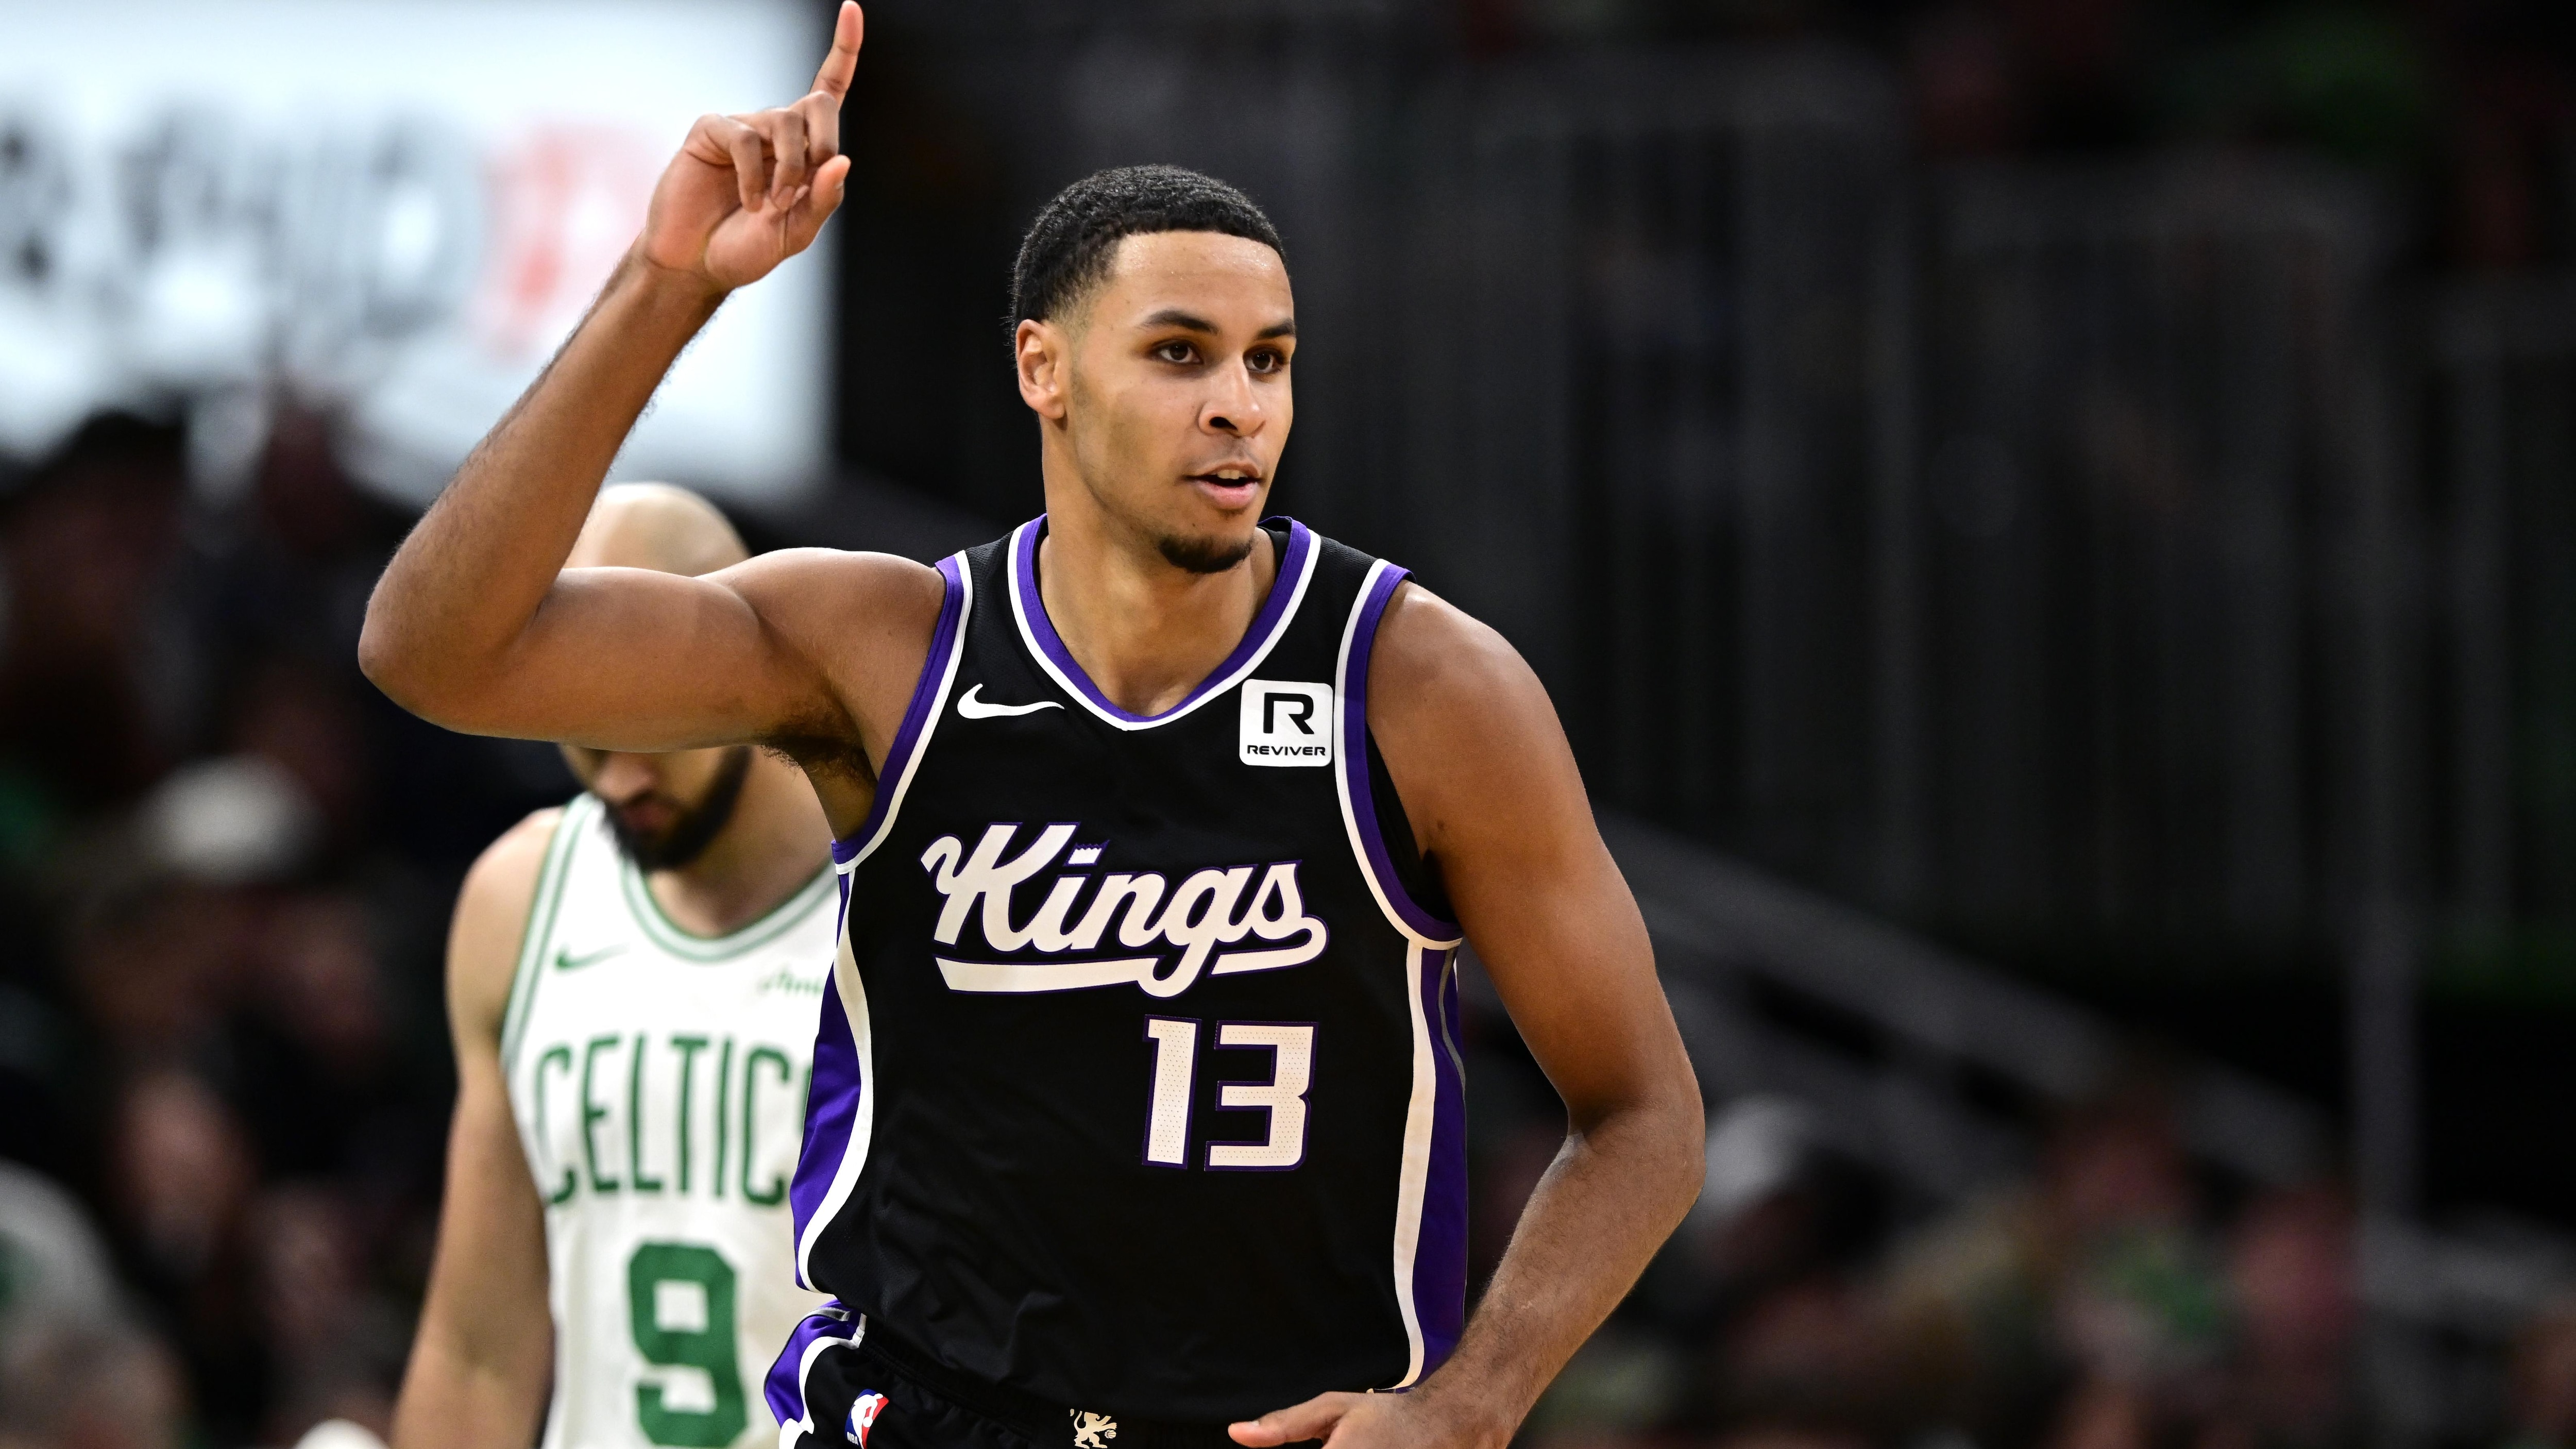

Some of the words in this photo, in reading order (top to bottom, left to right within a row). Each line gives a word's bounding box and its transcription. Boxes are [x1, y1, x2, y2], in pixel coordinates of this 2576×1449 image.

[1247, 745, 1326, 756] REVIVER
[1263, 692, 1315, 735] R
[920, 821, 1330, 1000] Kings
[532, 1032, 815, 1207] CELTIC
[1141, 1014, 1319, 1172] 13
[628, 1239, 750, 1449] 9
[846, 1431, 859, 1446] NBA
